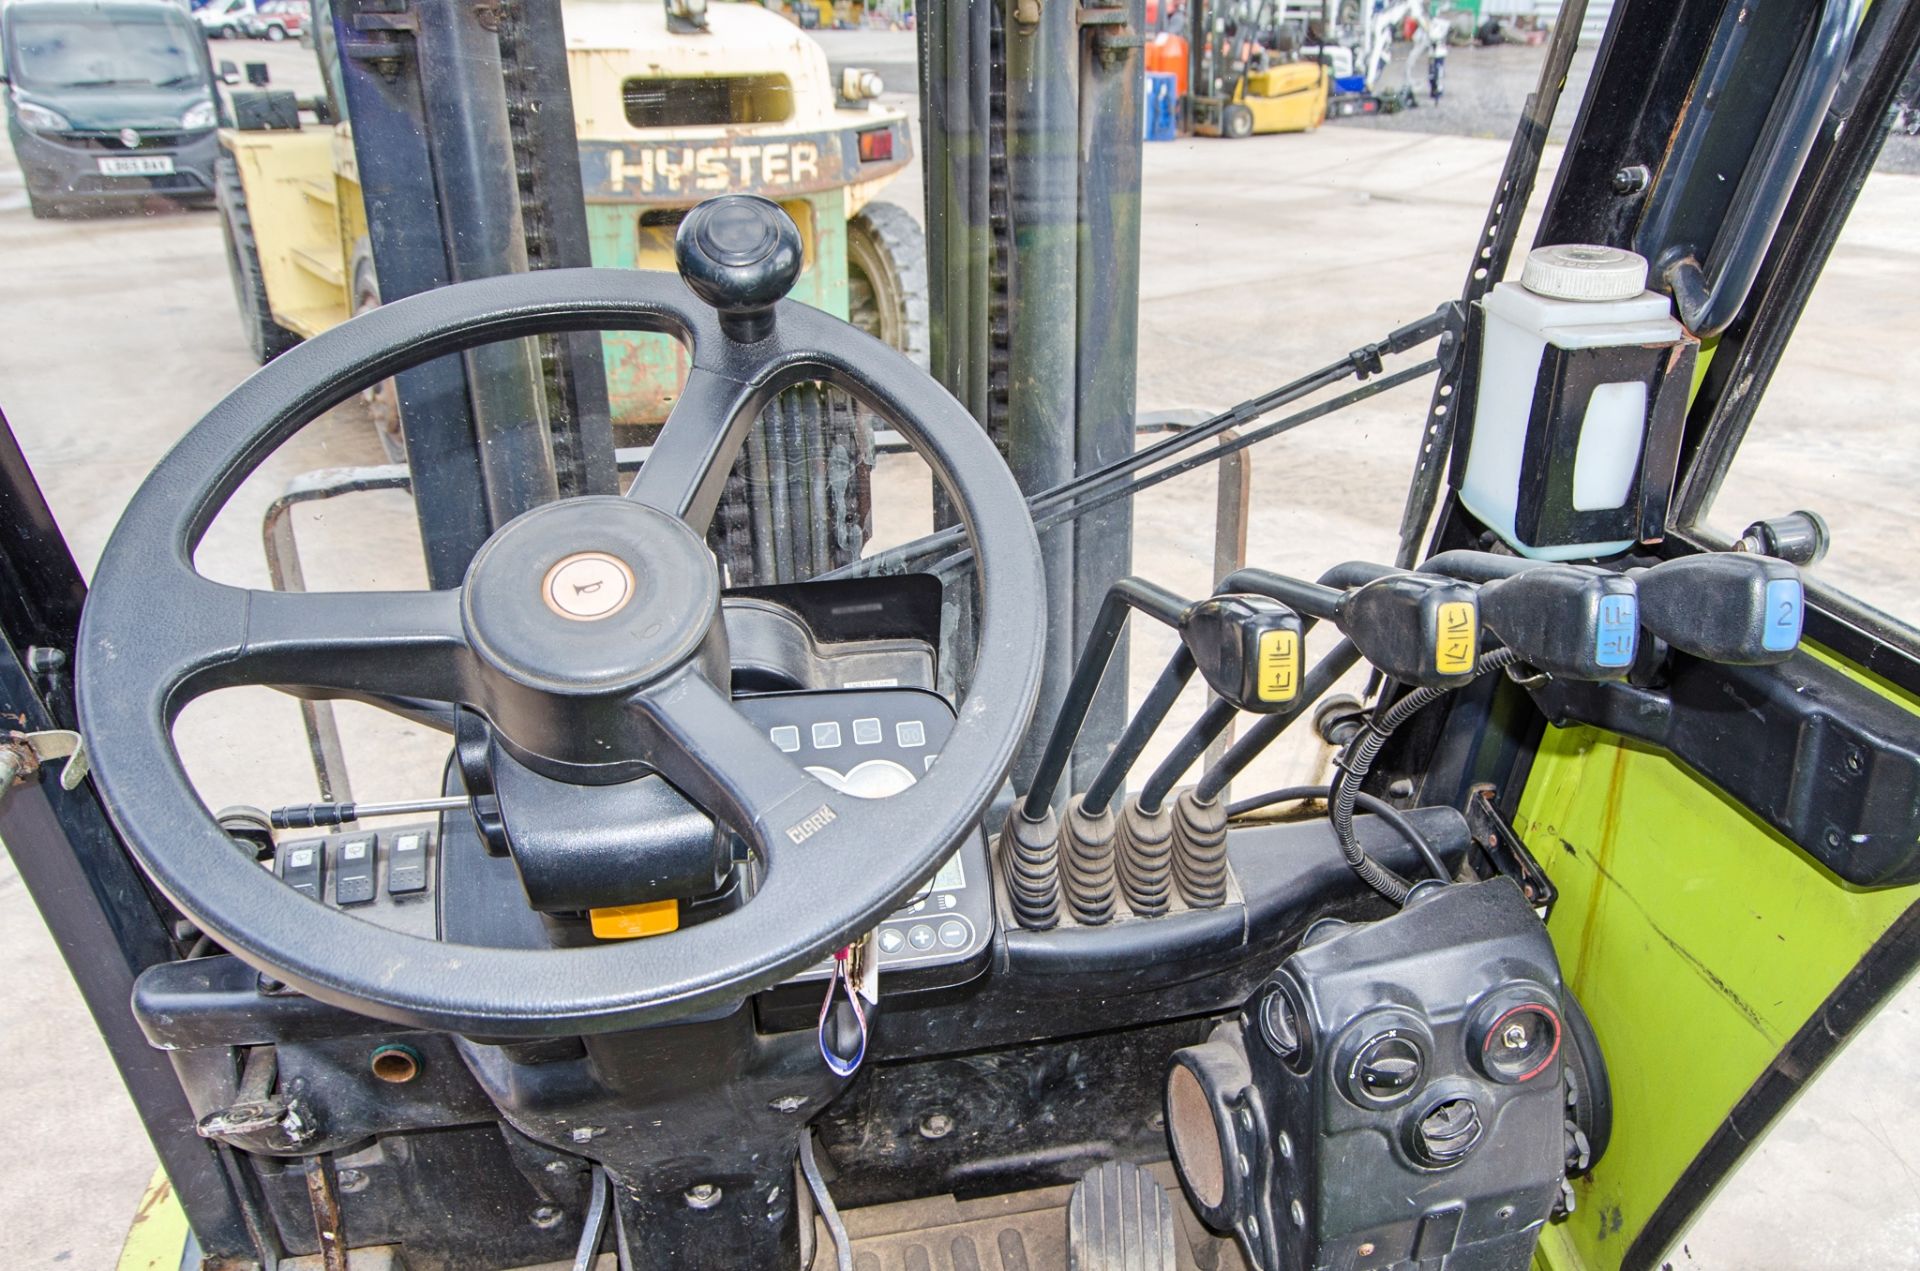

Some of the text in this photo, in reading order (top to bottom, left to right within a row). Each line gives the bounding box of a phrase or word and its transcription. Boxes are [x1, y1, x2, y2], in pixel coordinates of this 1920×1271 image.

[610, 143, 819, 193] HYSTER
[1777, 601, 1793, 627] 2
[785, 804, 837, 845] CLARK
